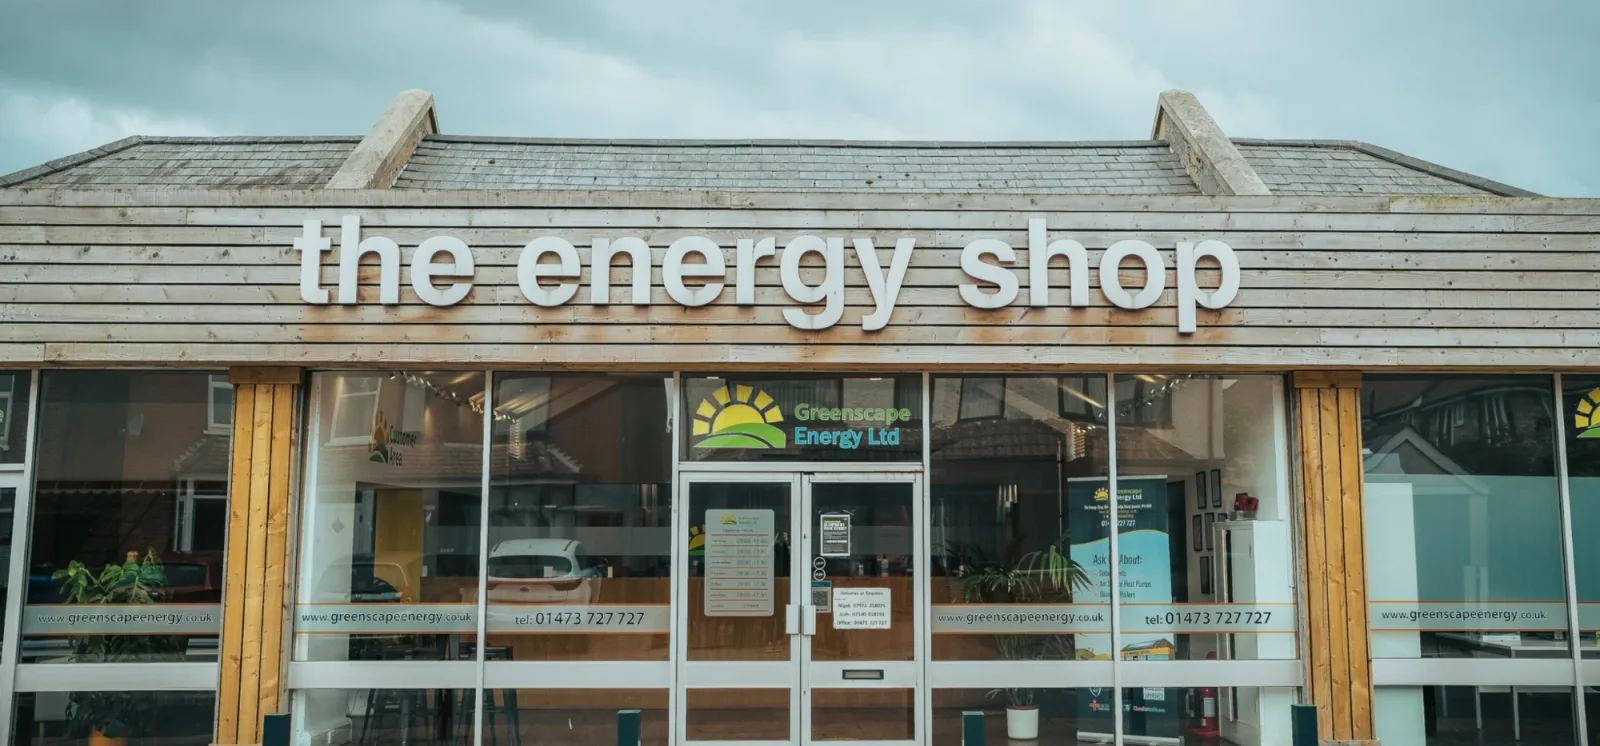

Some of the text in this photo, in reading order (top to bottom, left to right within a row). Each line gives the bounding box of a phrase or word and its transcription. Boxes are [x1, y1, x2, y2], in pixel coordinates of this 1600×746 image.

[293, 215, 1242, 333] the energy shop
[794, 402, 912, 426] Greenscape
[794, 426, 900, 449] Energy Ltd
[390, 446, 403, 466] Area
[1093, 553, 1107, 565] Ask
[1119, 554, 1143, 565] About:
[38, 612, 212, 625] www.greenscapeenergy.co.uk
[302, 611, 472, 625] www.greenscapeenergy.co.uk
[515, 612, 645, 625] tel: 01473 727 727
[938, 612, 1104, 625] www.greenscapeenergy.co.uk
[1145, 612, 1272, 625] tel: 01473 727 727
[1382, 610, 1546, 622] www.greenscapeenergy.co.uk
